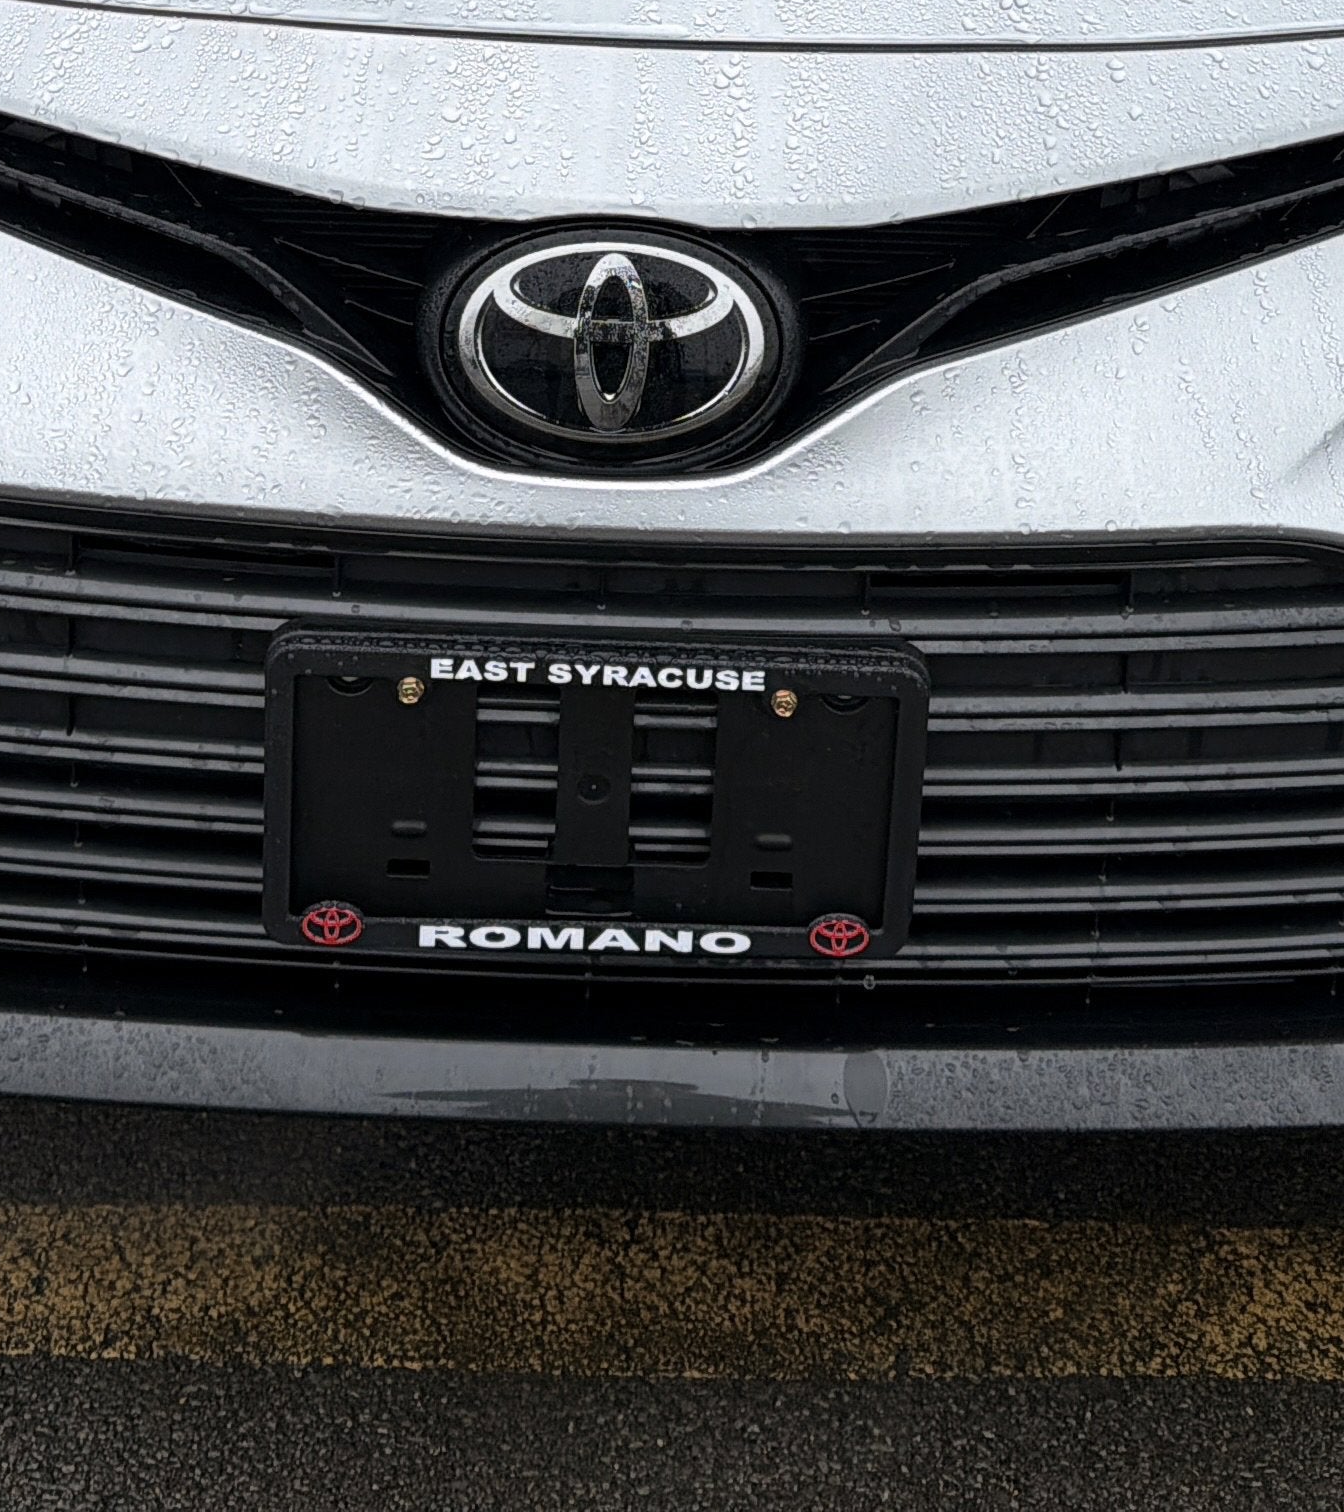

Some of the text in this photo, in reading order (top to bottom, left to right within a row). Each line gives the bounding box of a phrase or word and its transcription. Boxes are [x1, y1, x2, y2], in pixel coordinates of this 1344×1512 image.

[430, 658, 766, 691] EAST SYRACUSE
[419, 925, 752, 954] ROMANO
